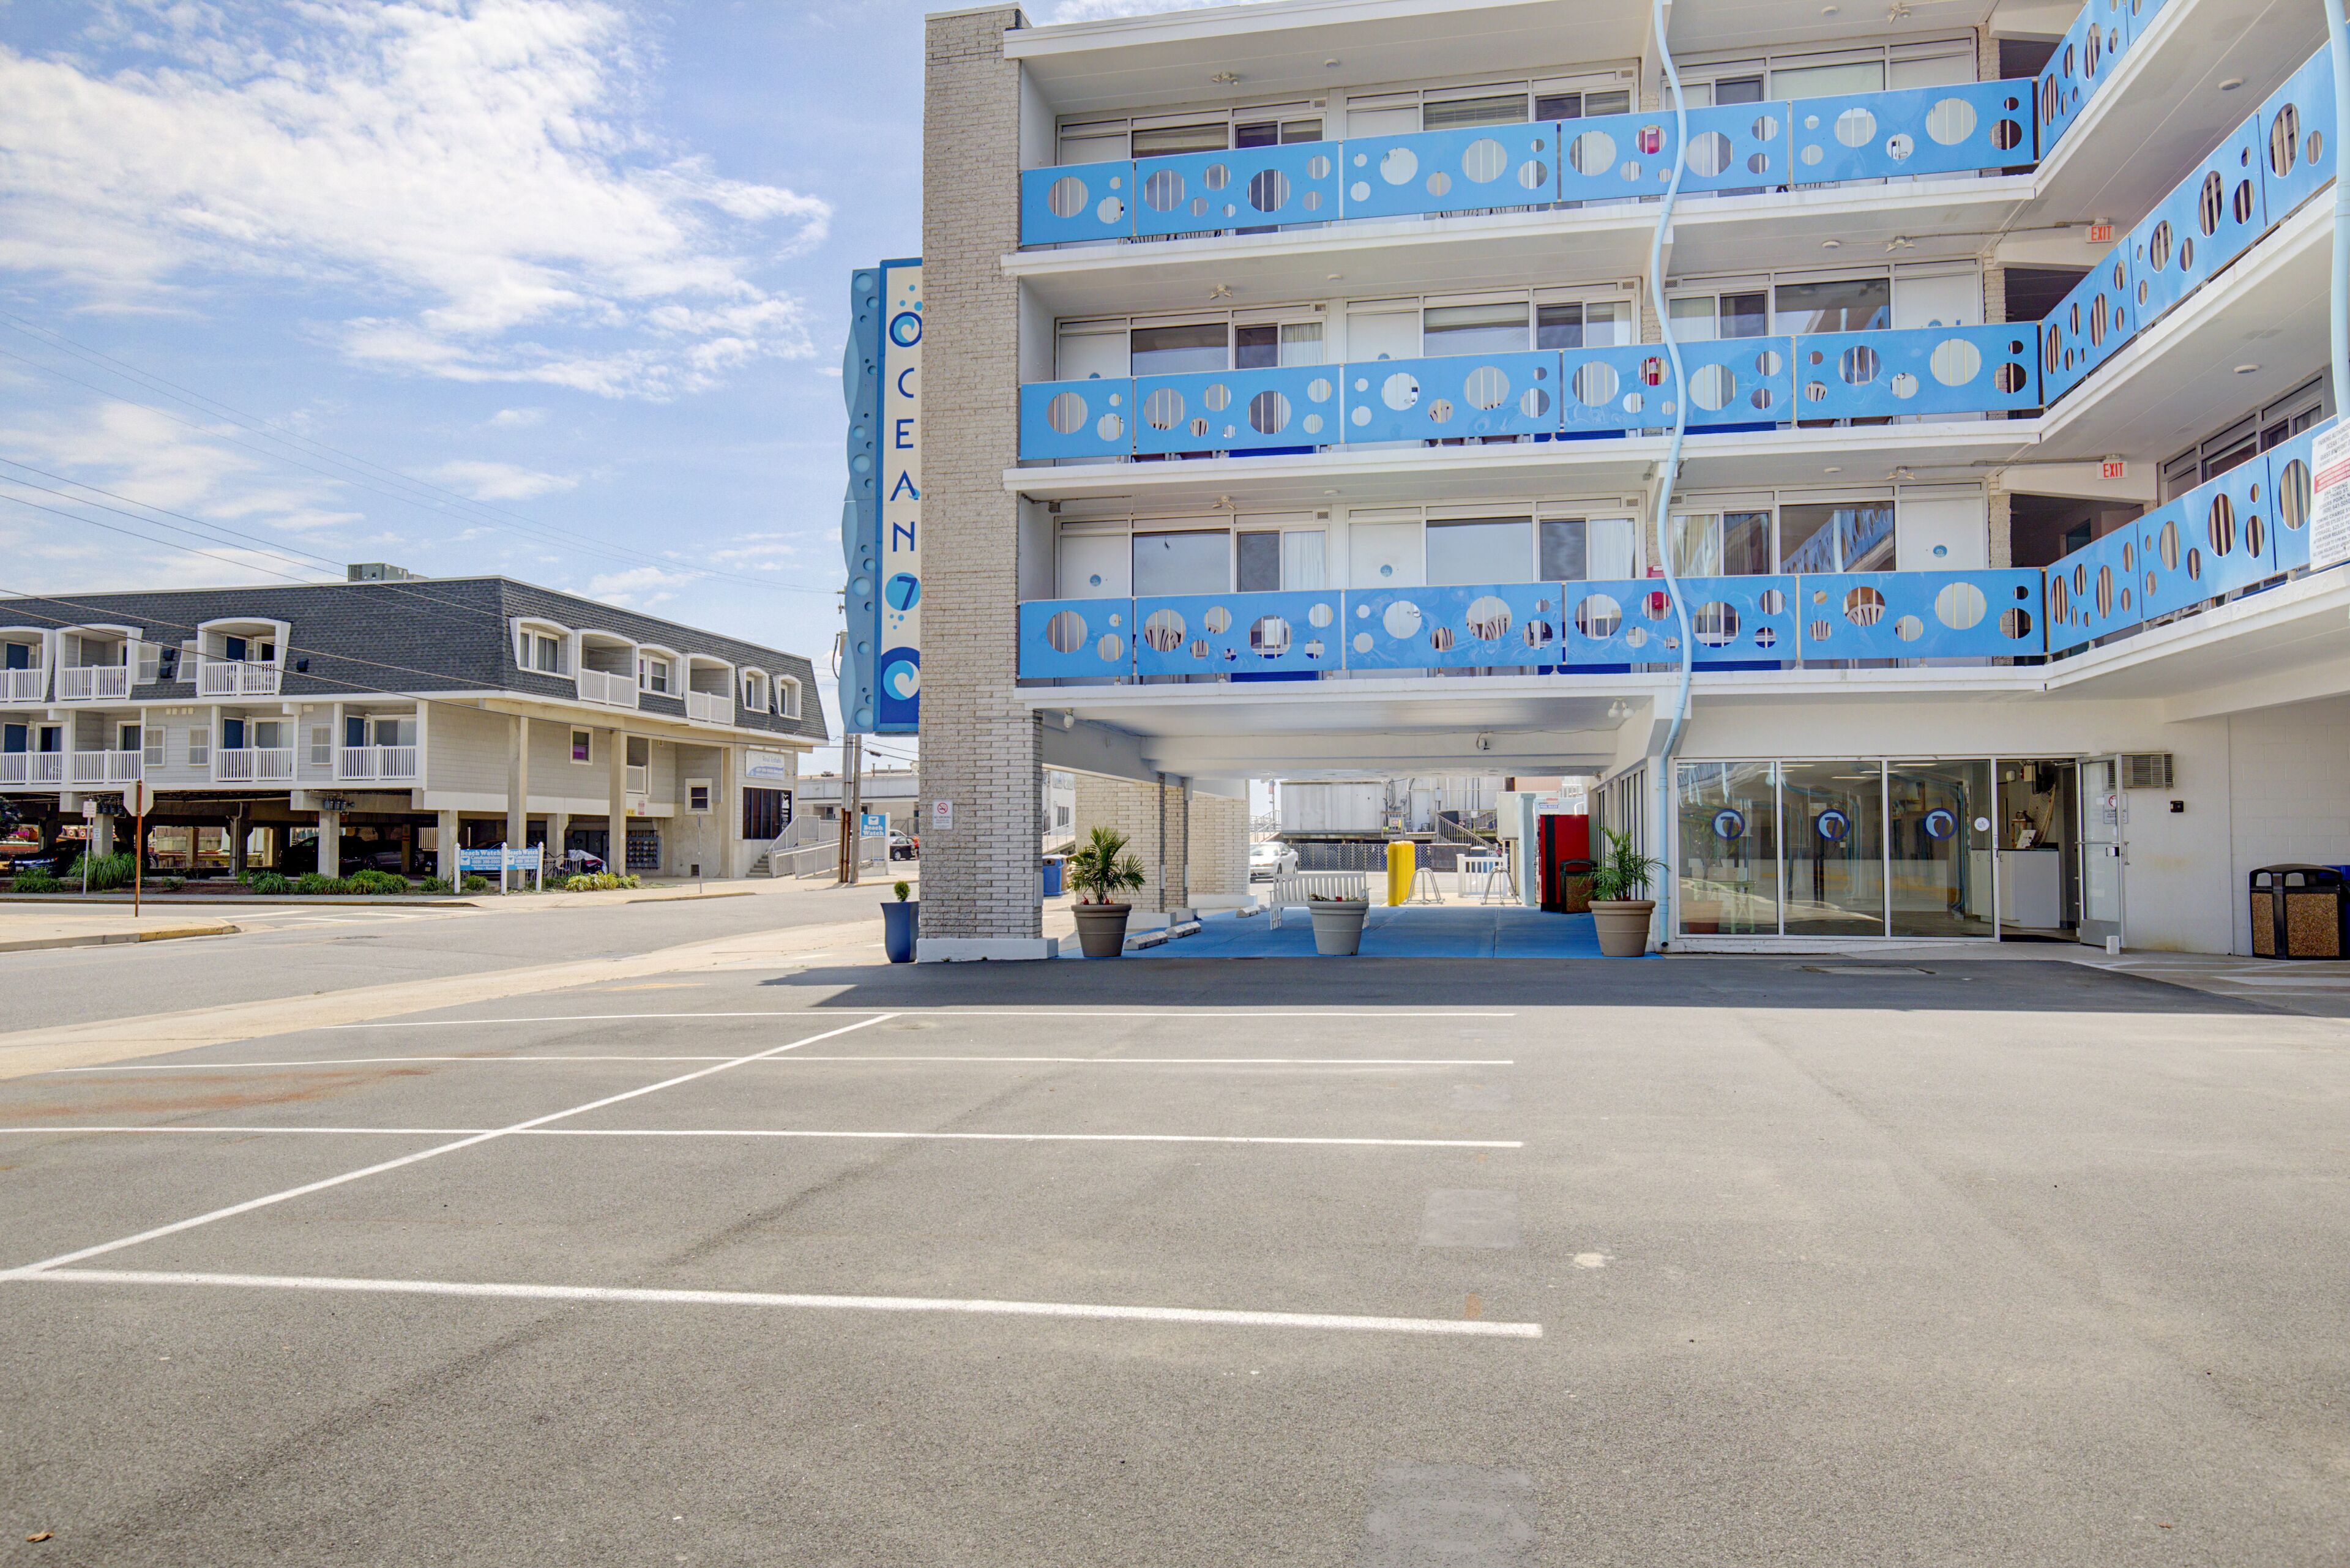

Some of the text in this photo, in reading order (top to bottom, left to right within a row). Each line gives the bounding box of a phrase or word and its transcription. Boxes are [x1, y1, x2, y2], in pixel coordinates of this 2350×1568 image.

[2091, 225, 2111, 241] EXIT
[889, 312, 922, 611] OCEAN 7
[2103, 463, 2124, 478] EXIT
[2330, 490, 2342, 499] THIRD
[2332, 482, 2348, 493] TOWING
[2329, 508, 2345, 519] CHARGE
[1720, 816, 1734, 838] 7
[1825, 816, 1839, 838] 7
[1932, 815, 1947, 838] 7
